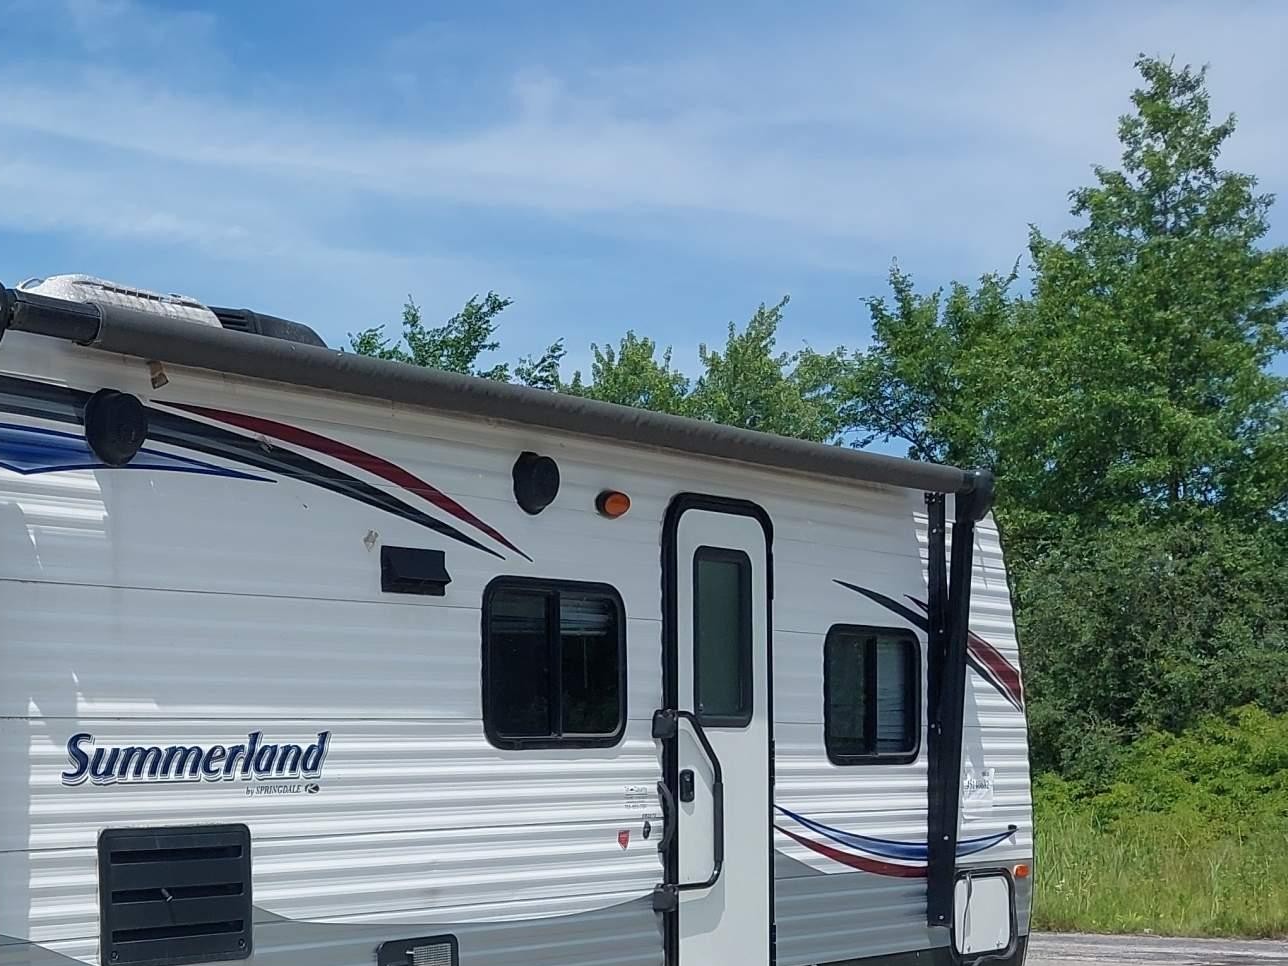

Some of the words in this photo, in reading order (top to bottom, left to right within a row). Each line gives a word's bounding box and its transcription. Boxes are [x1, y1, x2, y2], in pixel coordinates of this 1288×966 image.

[61, 730, 332, 785] Summerland
[245, 786, 255, 797] by
[255, 784, 303, 796] SPRINGDALE
